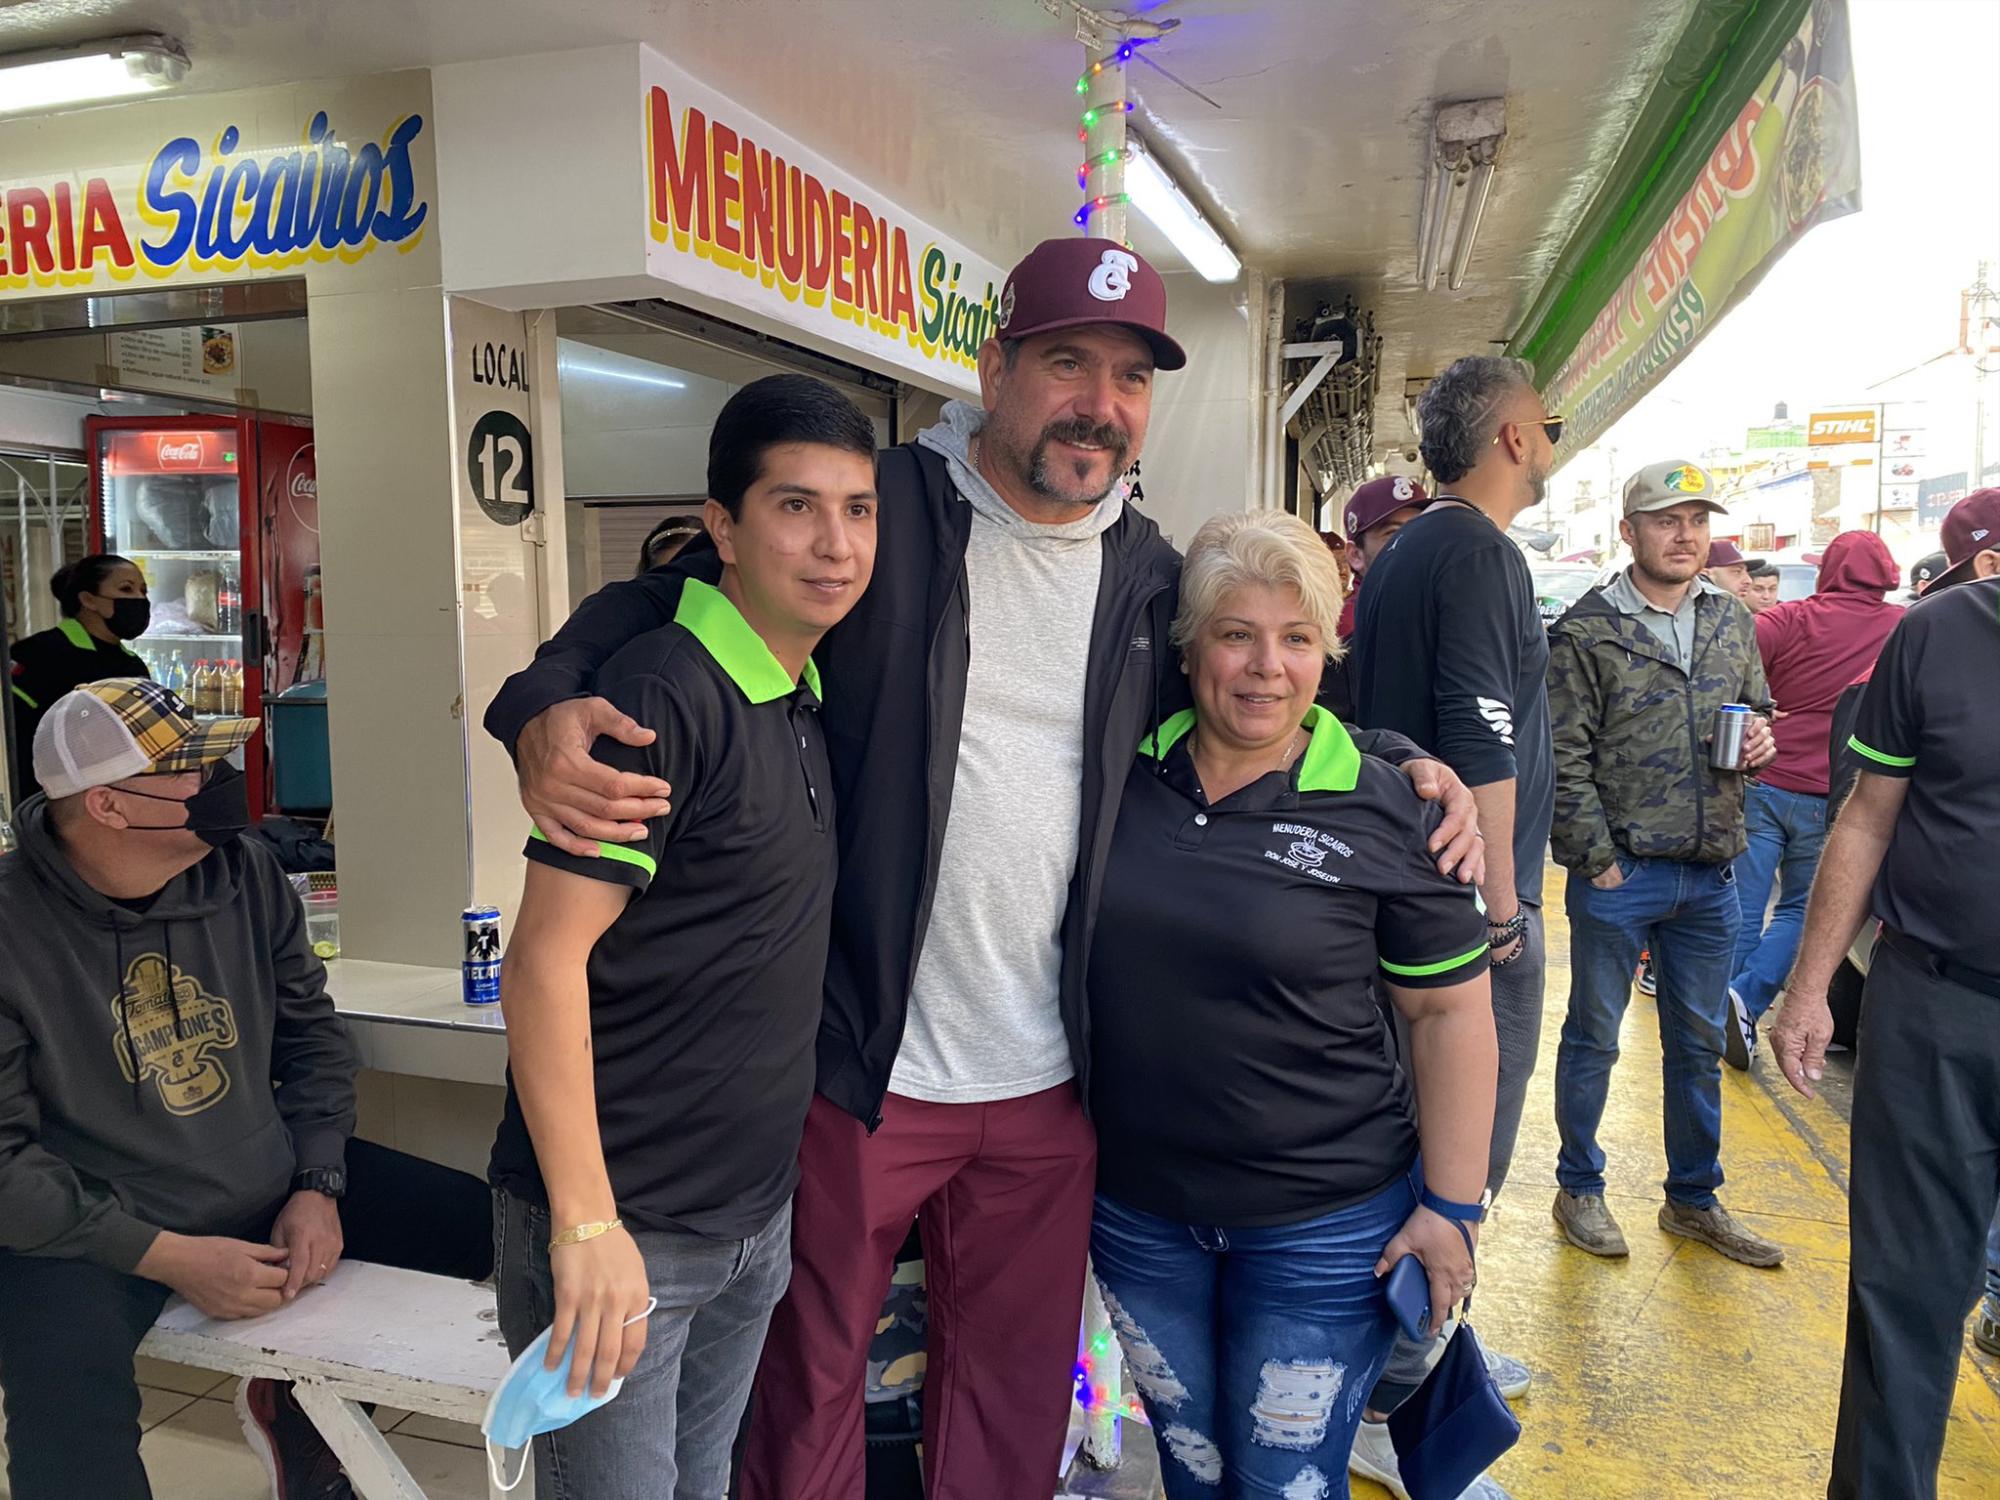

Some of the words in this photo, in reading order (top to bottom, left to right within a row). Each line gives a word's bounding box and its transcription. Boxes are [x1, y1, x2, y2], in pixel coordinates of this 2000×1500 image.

[0, 177, 135, 276] RIA
[141, 110, 427, 266] Sicairos
[651, 86, 917, 333] MENUDERIA
[472, 342, 530, 392] LOCAL
[1811, 419, 1872, 435] STIHL
[291, 472, 317, 498] Coca
[478, 434, 529, 504] 12
[1272, 823, 1319, 839] MENUDERIA
[1318, 833, 1354, 858] SICAIROS
[1264, 850, 1281, 862] DON
[1300, 863, 1308, 871] Y
[1307, 867, 1341, 884] JOSELYN
